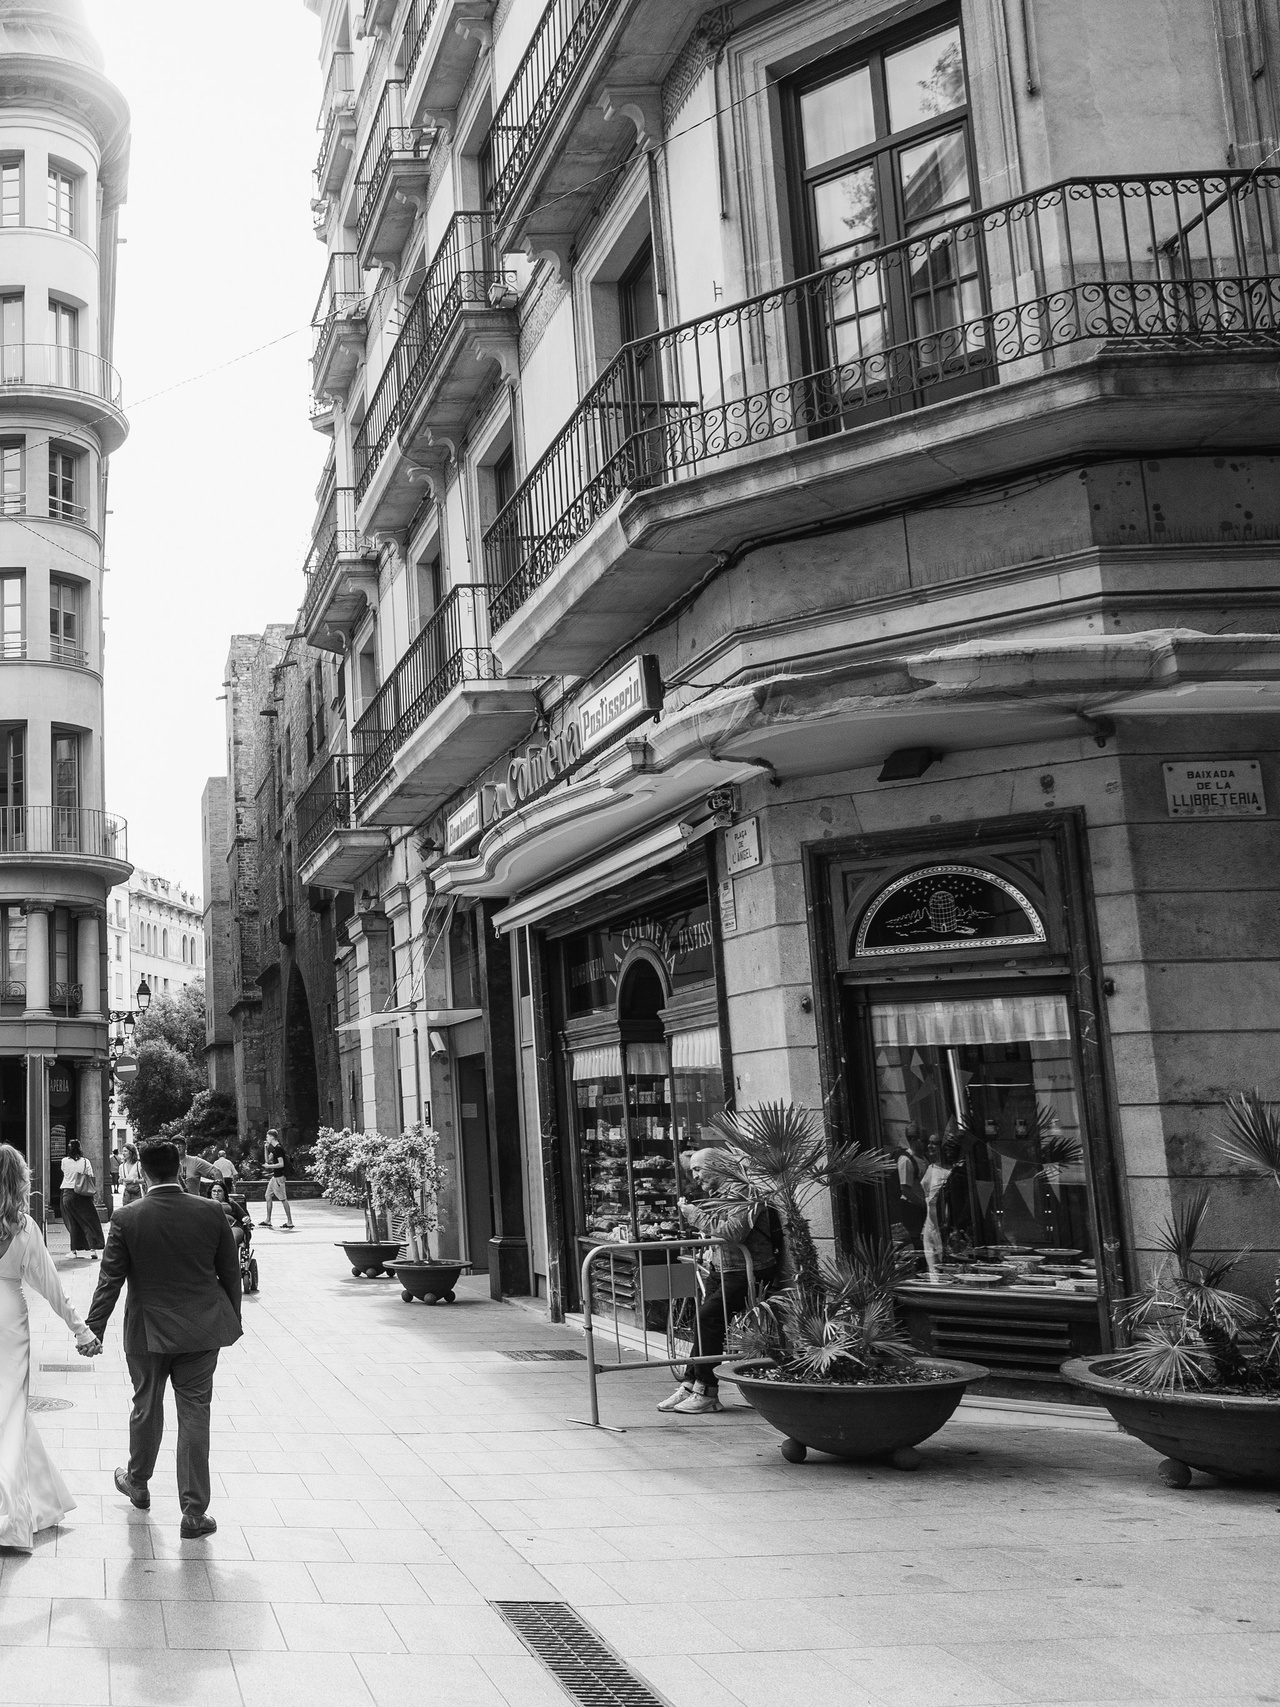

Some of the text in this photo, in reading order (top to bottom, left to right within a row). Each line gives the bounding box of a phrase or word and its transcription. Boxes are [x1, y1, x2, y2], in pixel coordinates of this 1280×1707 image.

[582, 676, 640, 742] Pastisseria
[506, 721, 581, 809] Colmena
[1187, 770, 1235, 779] BAIXADA
[1197, 781, 1231, 790] DE LA
[1172, 792, 1259, 807] LLIBRETERIA
[734, 830, 747, 840] PLAÇA
[738, 840, 744, 848] DE
[621, 916, 676, 975] COLMENA
